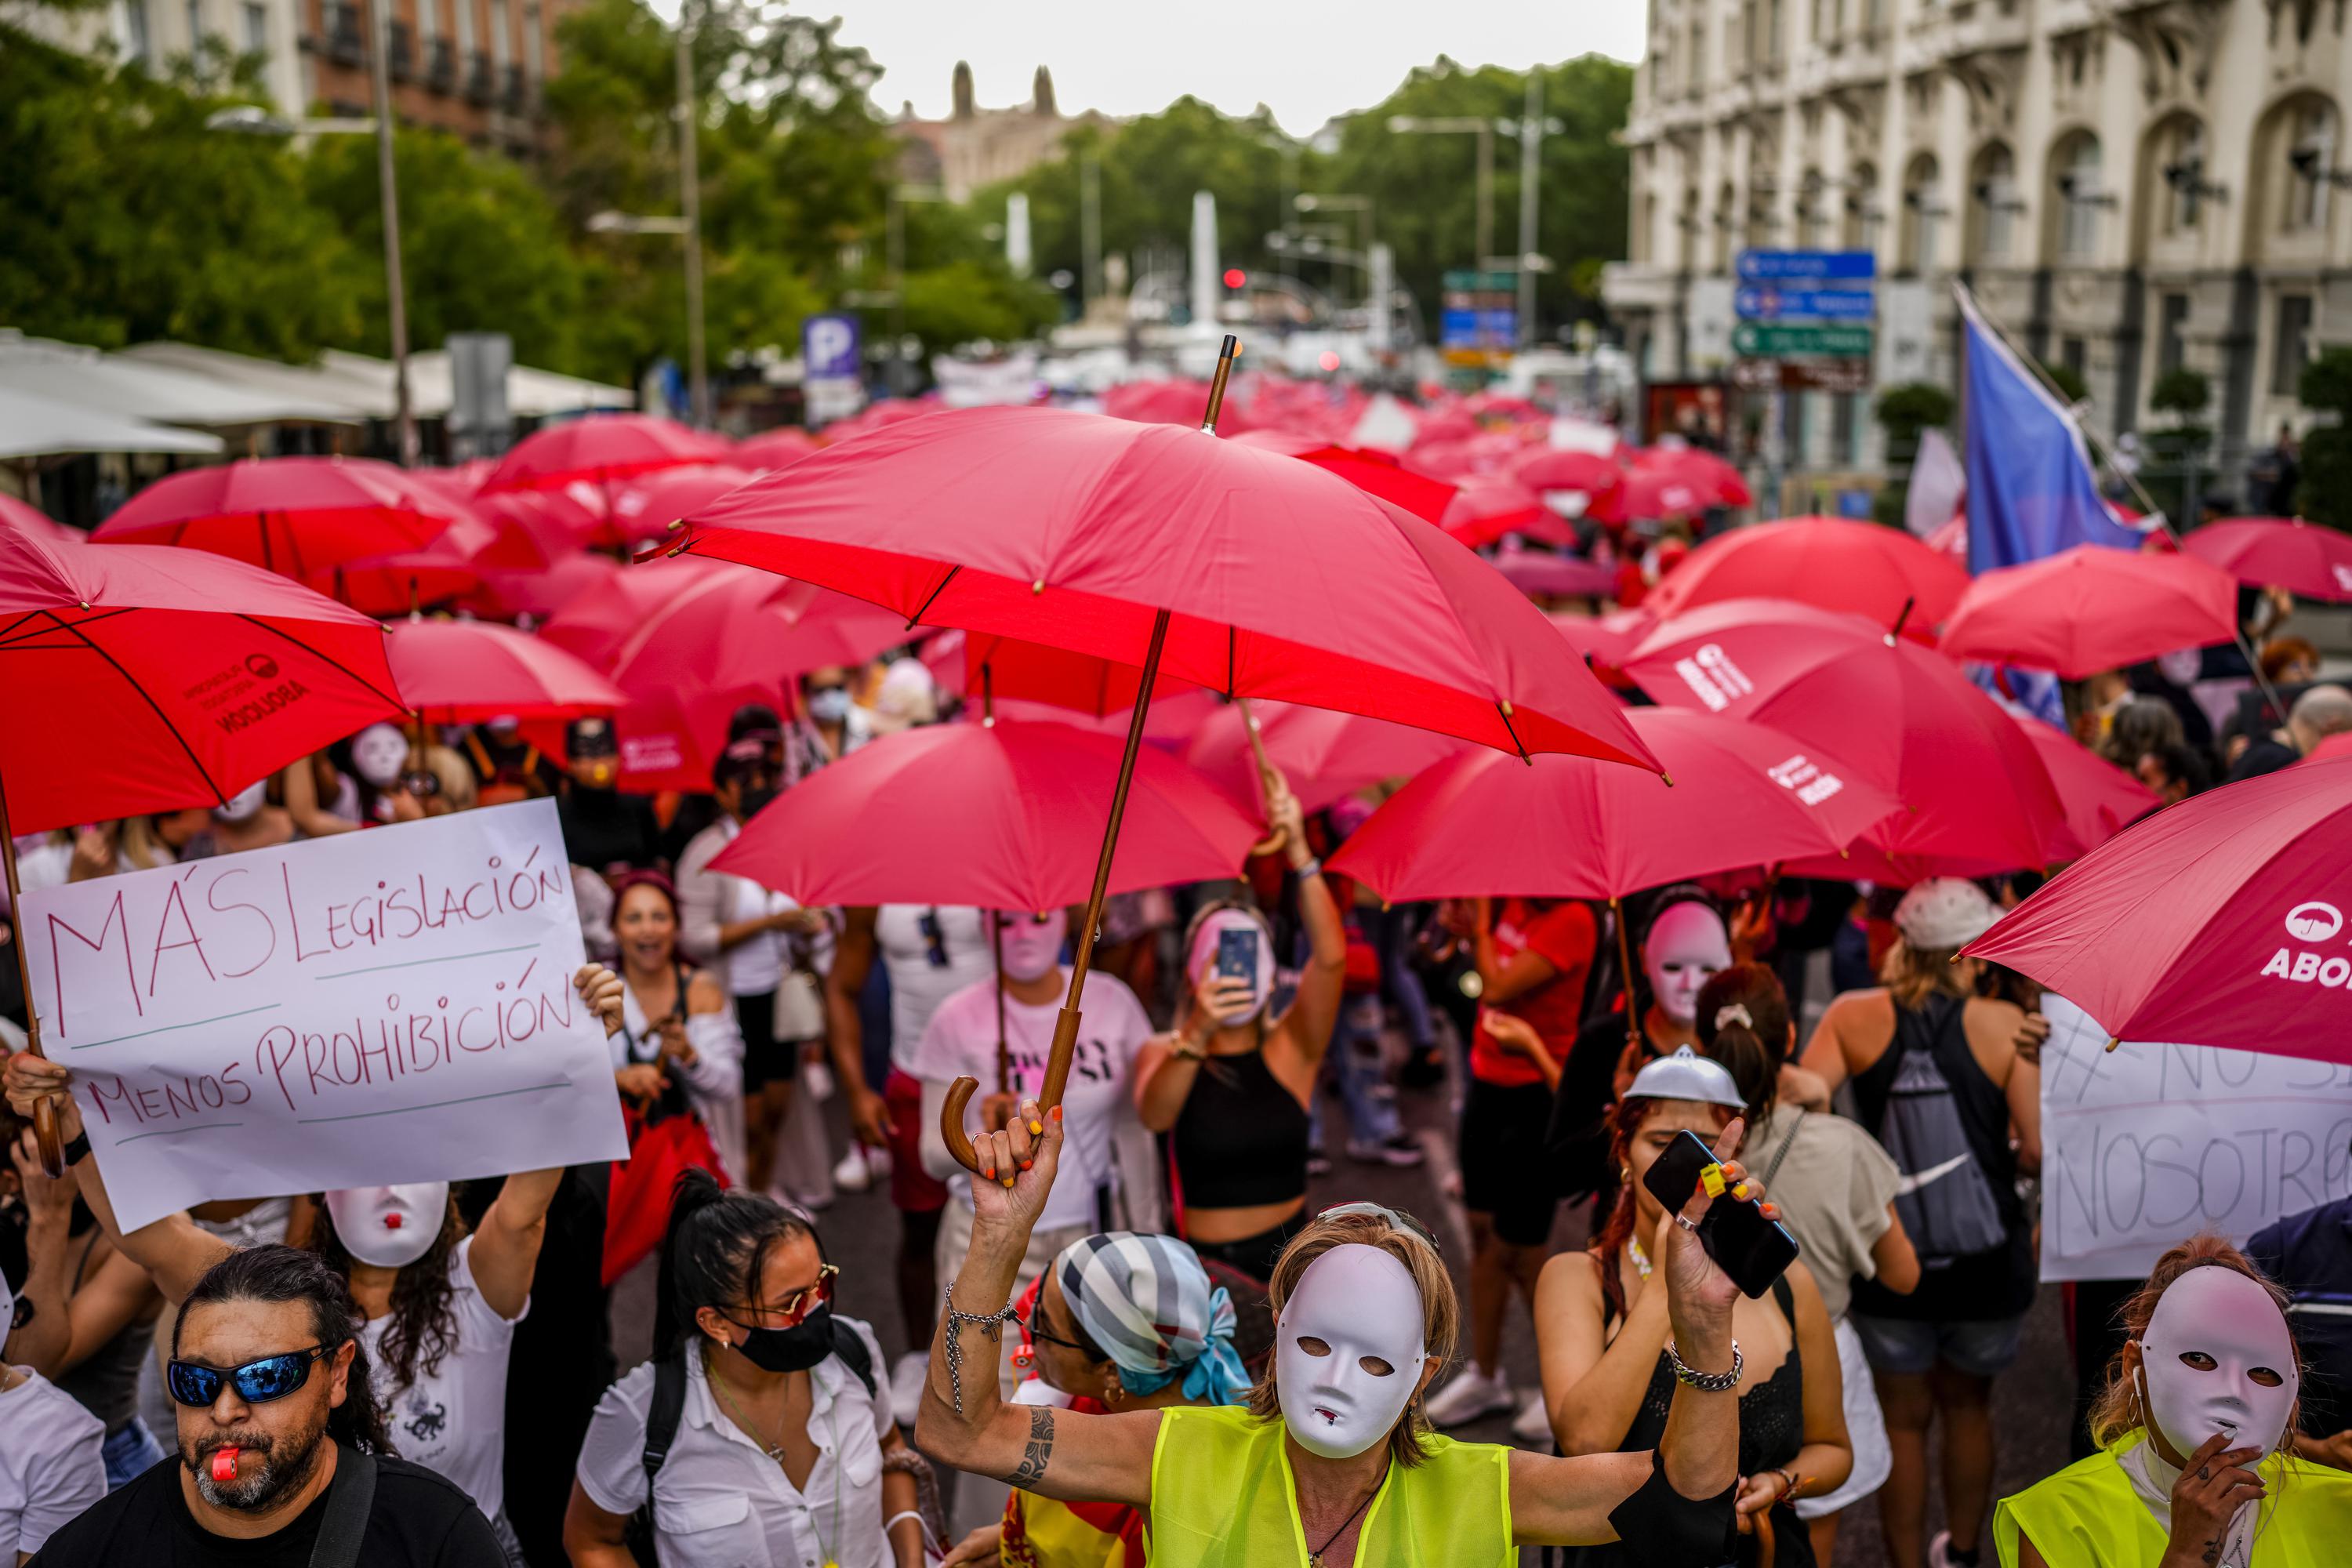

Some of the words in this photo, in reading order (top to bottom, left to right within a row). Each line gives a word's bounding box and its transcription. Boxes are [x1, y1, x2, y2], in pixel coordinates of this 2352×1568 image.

[49, 865, 277, 1038] MÁS
[2259, 947, 2352, 990] ABO
[87, 1062, 252, 1125] MENOS
